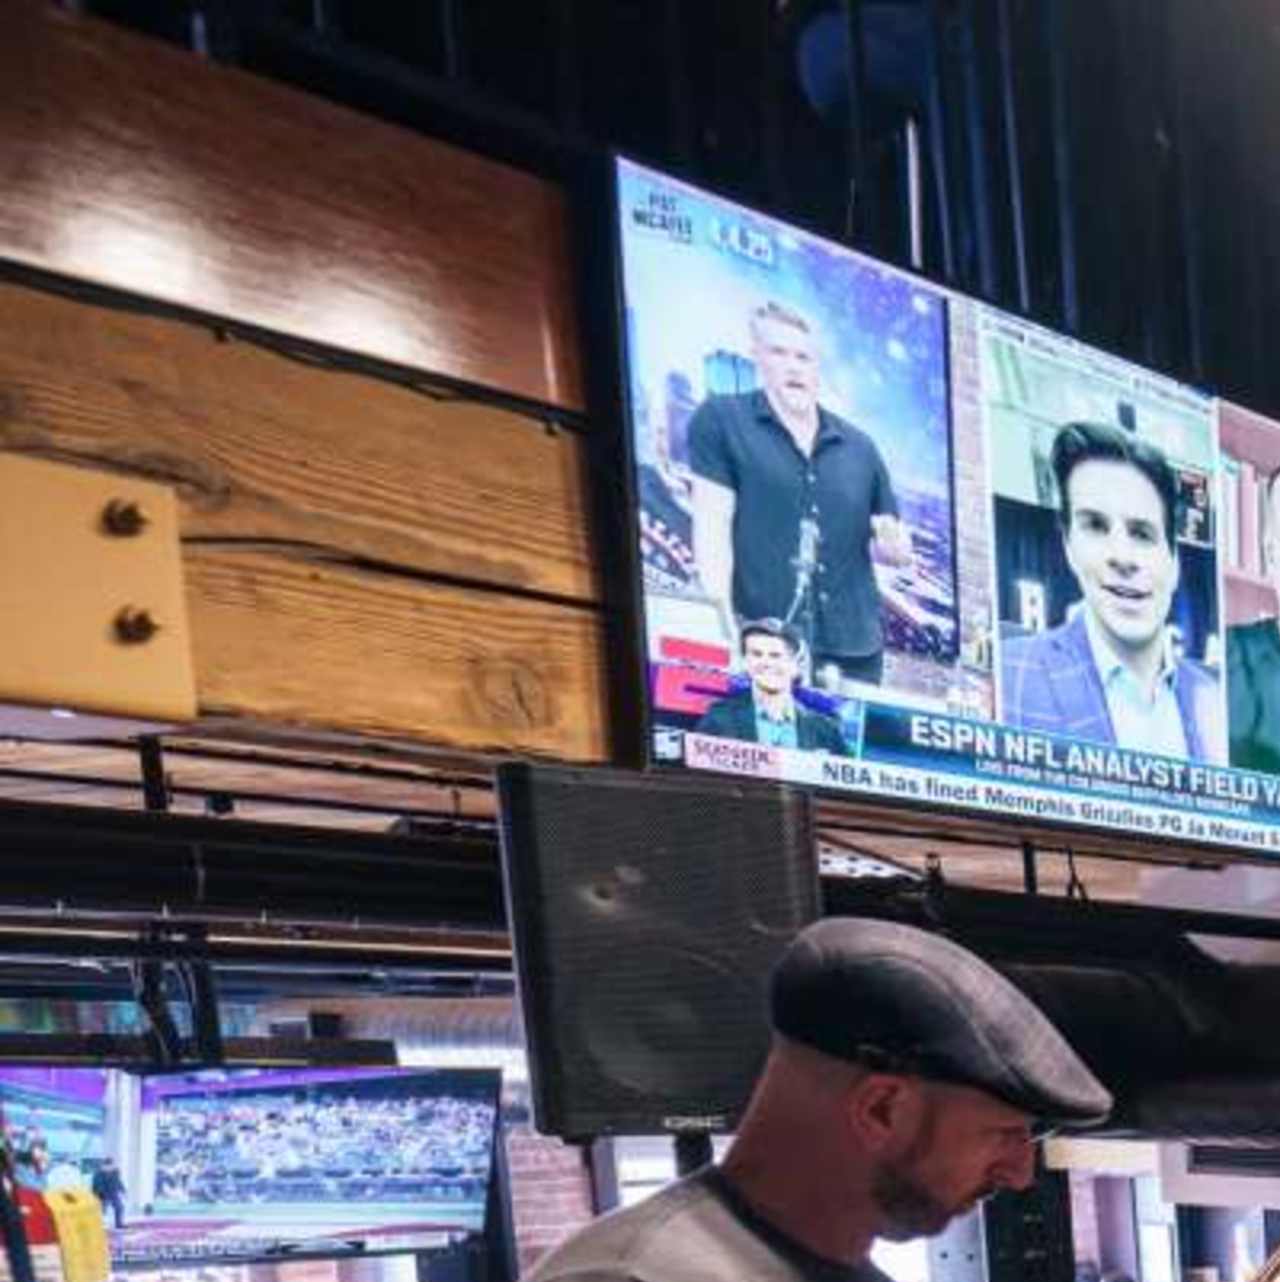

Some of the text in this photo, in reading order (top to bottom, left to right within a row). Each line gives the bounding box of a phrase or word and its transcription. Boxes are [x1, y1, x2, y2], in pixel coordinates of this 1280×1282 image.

[822, 761, 873, 786] NBA
[879, 769, 920, 794] has
[926, 776, 979, 802] fined
[984, 786, 1076, 819] Memphis
[1080, 801, 1153, 828] Grizzlies
[1158, 814, 1183, 833] PG
[911, 714, 996, 759] ESPN
[1004, 733, 1061, 769] NFL
[1066, 744, 1184, 789] ANALYST
[1190, 767, 1258, 801] FIELD
